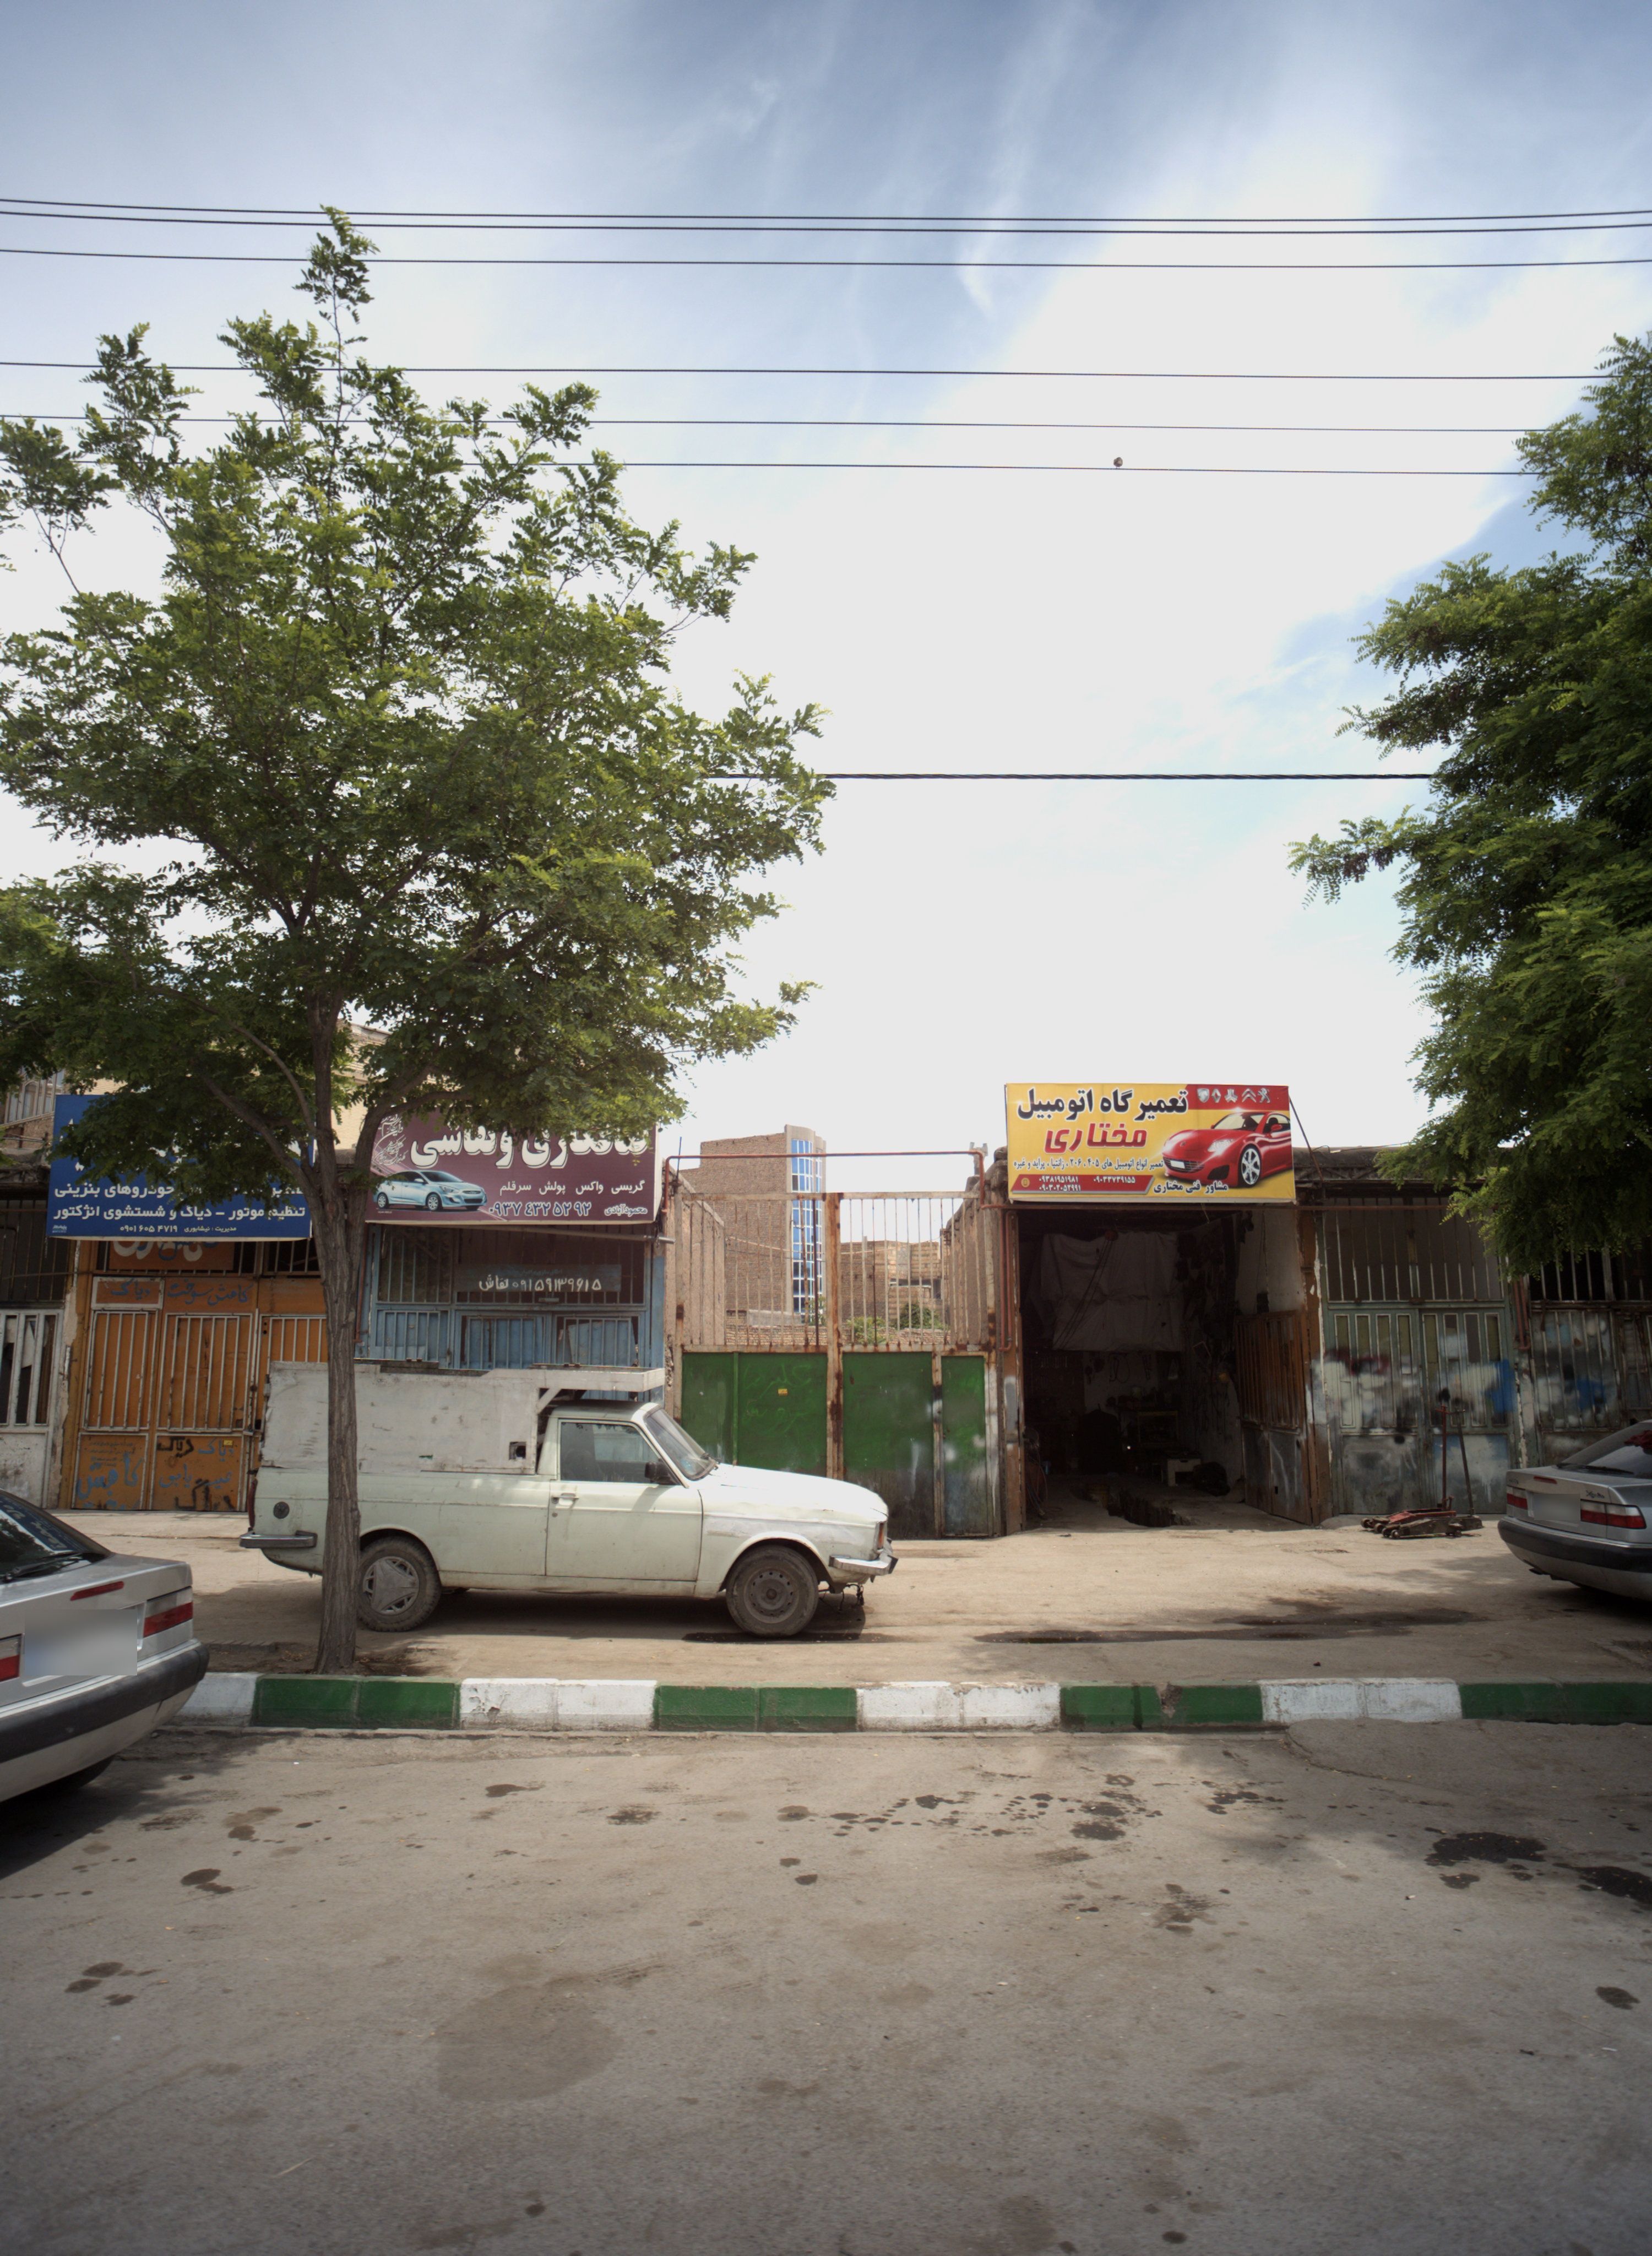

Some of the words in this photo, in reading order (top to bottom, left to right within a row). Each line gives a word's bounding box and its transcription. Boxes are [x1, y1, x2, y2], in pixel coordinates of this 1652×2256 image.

[1018, 1088, 1093, 1120] اتومبیل
[1134, 1089, 1188, 1121] تعمیر
[1044, 1122, 1147, 1153] مختاری
[1013, 1158, 1025, 1169] غیره
[1028, 1161, 1031, 1170] و
[1032, 1158, 1045, 1170] پراید
[1051, 1158, 1065, 1170] زانتیا
[1101, 1158, 1112, 1170] های
[1114, 1158, 1134, 1170] اتومبیل
[1135, 1158, 1148, 1171] انواع
[1149, 1160, 1164, 1170] تعمیر
[55, 1183, 100, 1197] بنزینی
[499, 1181, 532, 1196] سرقلم
[539, 1181, 566, 1195] پولش
[575, 1181, 605, 1195] واکس
[611, 1180, 645, 1195] گریسی
[1153, 1181, 1183, 1194] مختاری
[1185, 1181, 1201, 1194] فنی
[1205, 1180, 1229, 1195] مشاور
[53, 1204, 100, 1219] انژکتور
[103, 1204, 166, 1220] شستشوی
[228, 1207, 265, 1221] موتور
